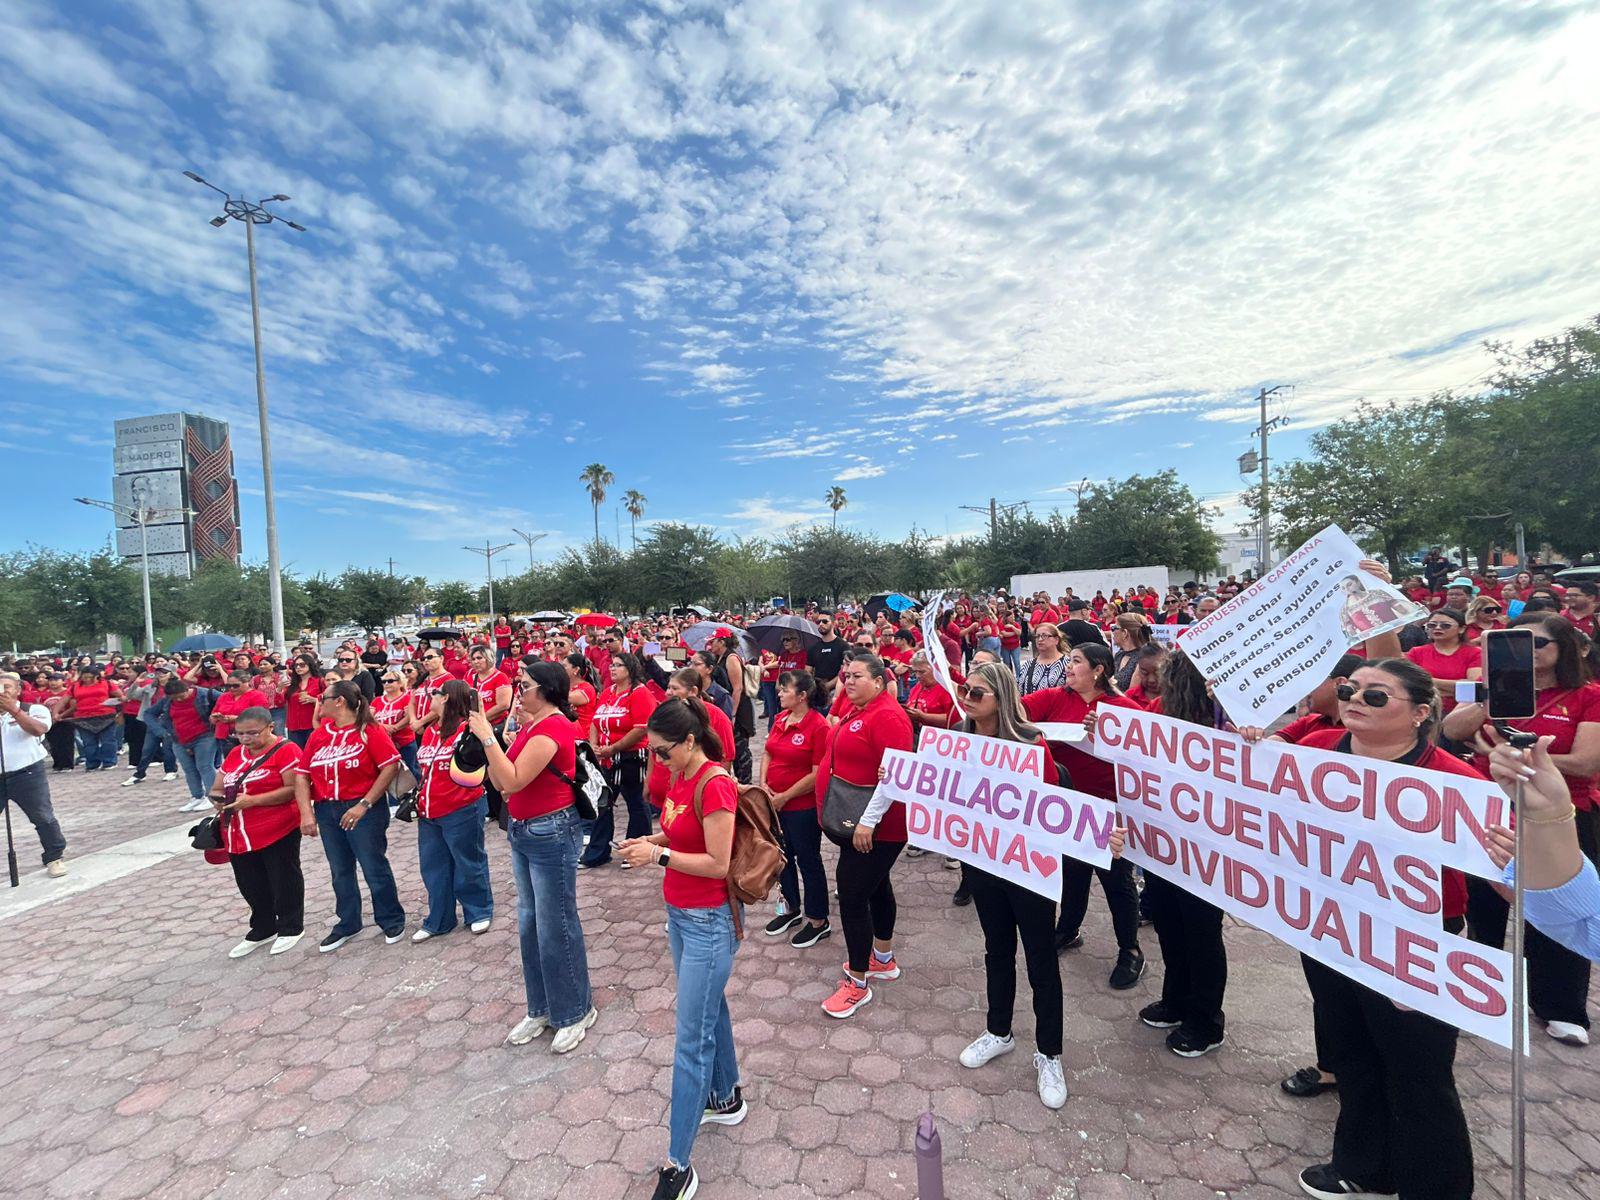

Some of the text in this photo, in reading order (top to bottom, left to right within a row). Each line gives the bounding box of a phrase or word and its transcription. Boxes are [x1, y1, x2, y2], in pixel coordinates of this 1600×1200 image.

[120, 423, 175, 435] FRANCISCO
[129, 451, 171, 462] MADERO
[1186, 595, 1249, 641] PROPUESTA
[1248, 582, 1266, 598] DE
[1191, 557, 1319, 660] Vamos a echar para
[1205, 559, 1344, 675] atrás con la ayuda de
[1238, 633, 1314, 692] el Regimen
[1251, 638, 1333, 710] de Pensiones
[345, 758, 359, 769] 30
[438, 761, 450, 770] 22
[919, 727, 1040, 777] POR UNA
[1097, 711, 1504, 854] CANCELACION
[881, 756, 1115, 850] JUBILACION
[908, 802, 1031, 873] DIGNA
[1117, 762, 1442, 915] DE CUENTAS
[1116, 811, 1508, 1017] INDIVIDUALES
